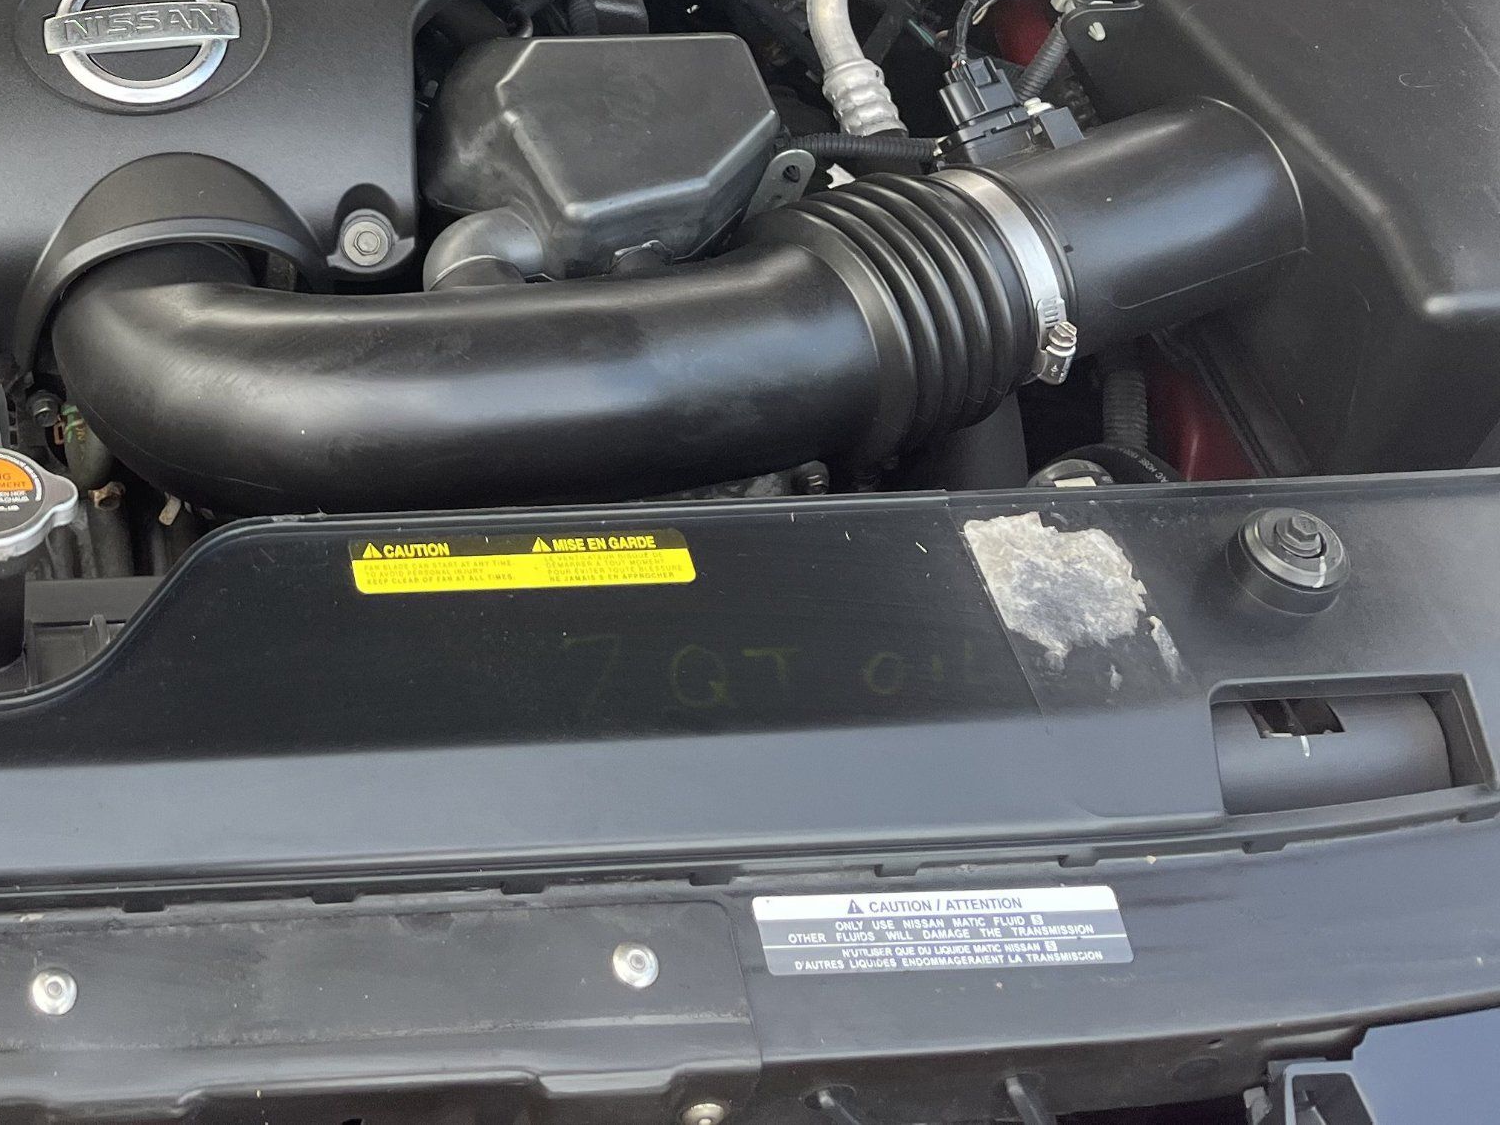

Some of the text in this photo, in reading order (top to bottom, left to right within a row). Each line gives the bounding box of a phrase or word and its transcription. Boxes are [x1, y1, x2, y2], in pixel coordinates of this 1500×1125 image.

[64, 6, 221, 44] NISSAN
[382, 542, 450, 558] CAUTION
[551, 535, 656, 551] MISE EN GARDE
[406, 568, 451, 576] PERSONAL
[432, 561, 458, 569] START
[366, 577, 388, 585] KEEP
[391, 576, 419, 584] CLEAR
[436, 575, 453, 583] FAN
[468, 574, 483, 582] ALL
[563, 574, 595, 582] JAMAIS
[621, 571, 674, 579] APPROCHER
[869, 899, 932, 913] CAUTION
[945, 897, 1022, 911] ATTENTION
[834, 920, 865, 932] ONLY
[871, 919, 896, 931] USE
[901, 917, 946, 930] NISSAN
[951, 916, 987, 928] MATIC
[992, 915, 1026, 926] FLUID
[786, 923, 1095, 945] OTHER FLUIDS WILL DAMAGE THE TRANSMISSION
[840, 947, 894, 959] N'UTILISER
[893, 946, 916, 957] QUE
[916, 945, 933, 956] DU
[933, 944, 972, 955] LIQUIDE
[972, 943, 1002, 954] MATIC
[1003, 941, 1041, 953] NISSAN
[793, 950, 1104, 972] D'AUTRES LIQUIDES ENDOMMAGERAIENT LA TRANSMISSION
